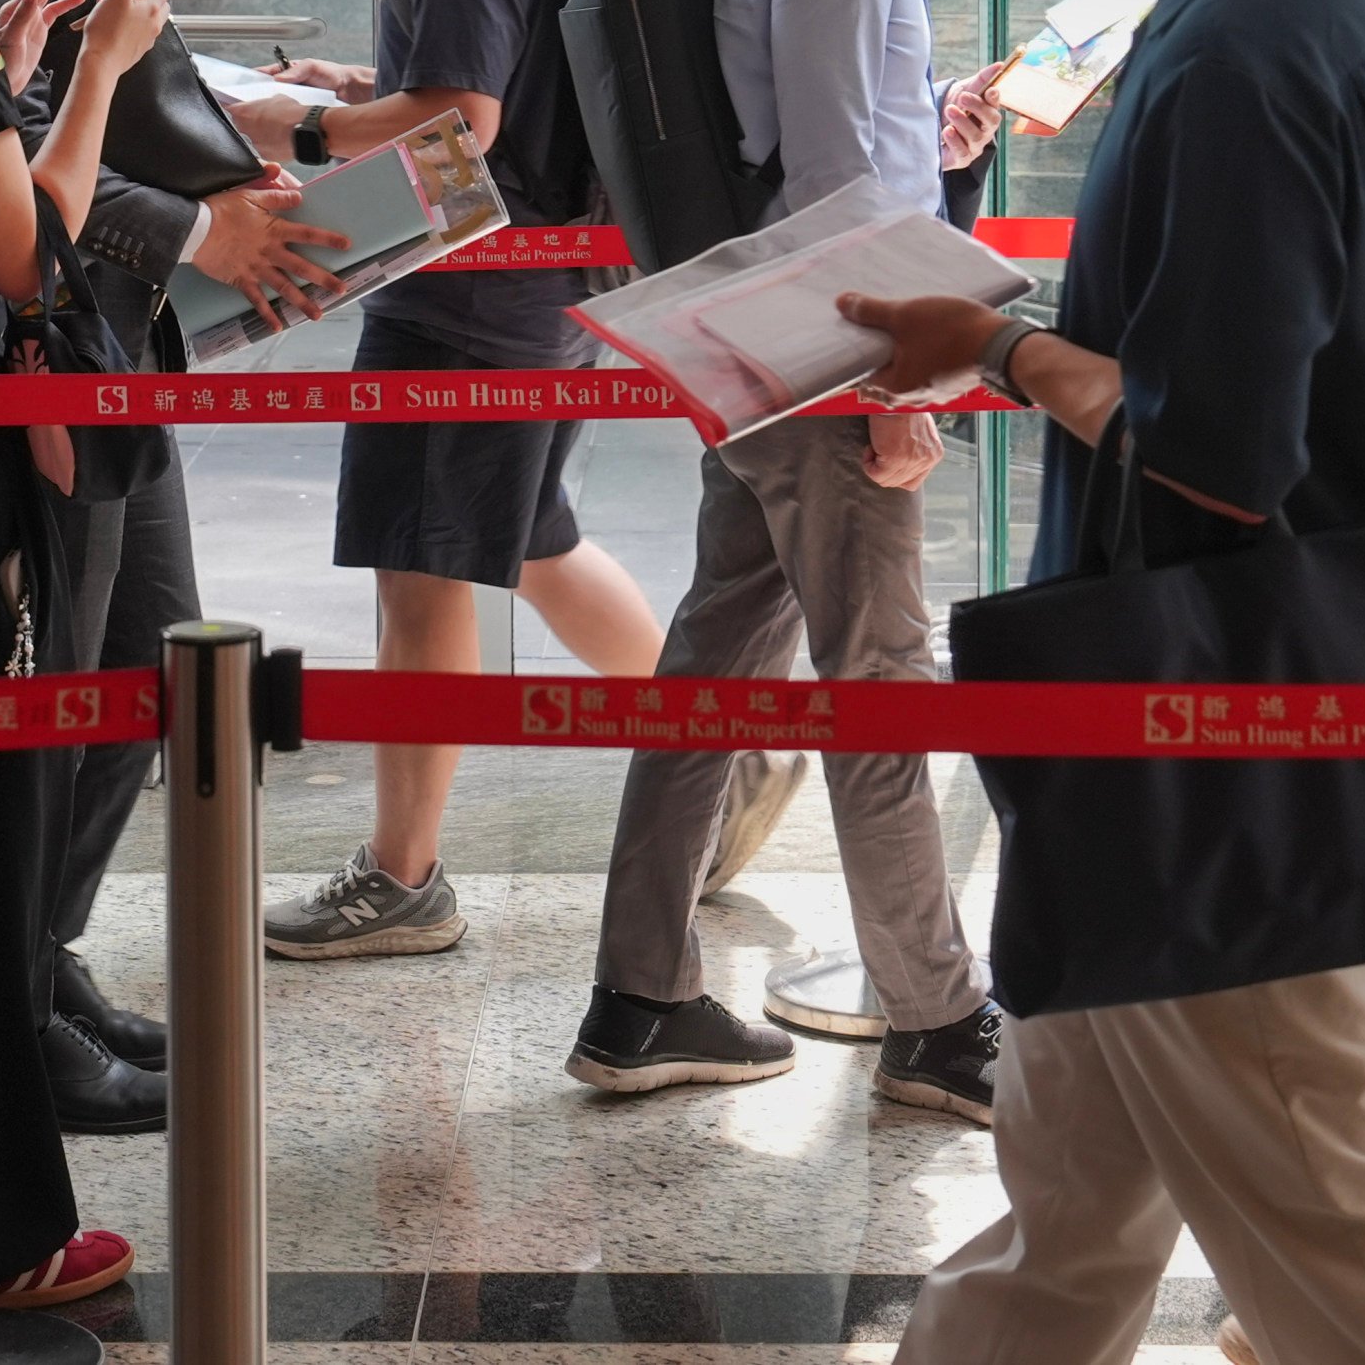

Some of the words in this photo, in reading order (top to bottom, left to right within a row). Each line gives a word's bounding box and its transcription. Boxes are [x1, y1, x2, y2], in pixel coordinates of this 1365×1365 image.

[451, 252, 474, 264] Sun
[477, 251, 508, 264] Hung
[511, 250, 531, 262] Kai
[534, 248, 592, 261] Properties
[406, 383, 459, 409] Sun
[469, 382, 543, 412] Hung
[554, 380, 601, 407] Kai
[577, 716, 623, 734] Sun
[625, 716, 681, 741] Hung
[688, 716, 724, 738] Kai
[730, 717, 834, 743] Properties
[1200, 723, 1242, 745] Sun
[1247, 723, 1304, 751] Hung
[1310, 723, 1347, 745] Kai
